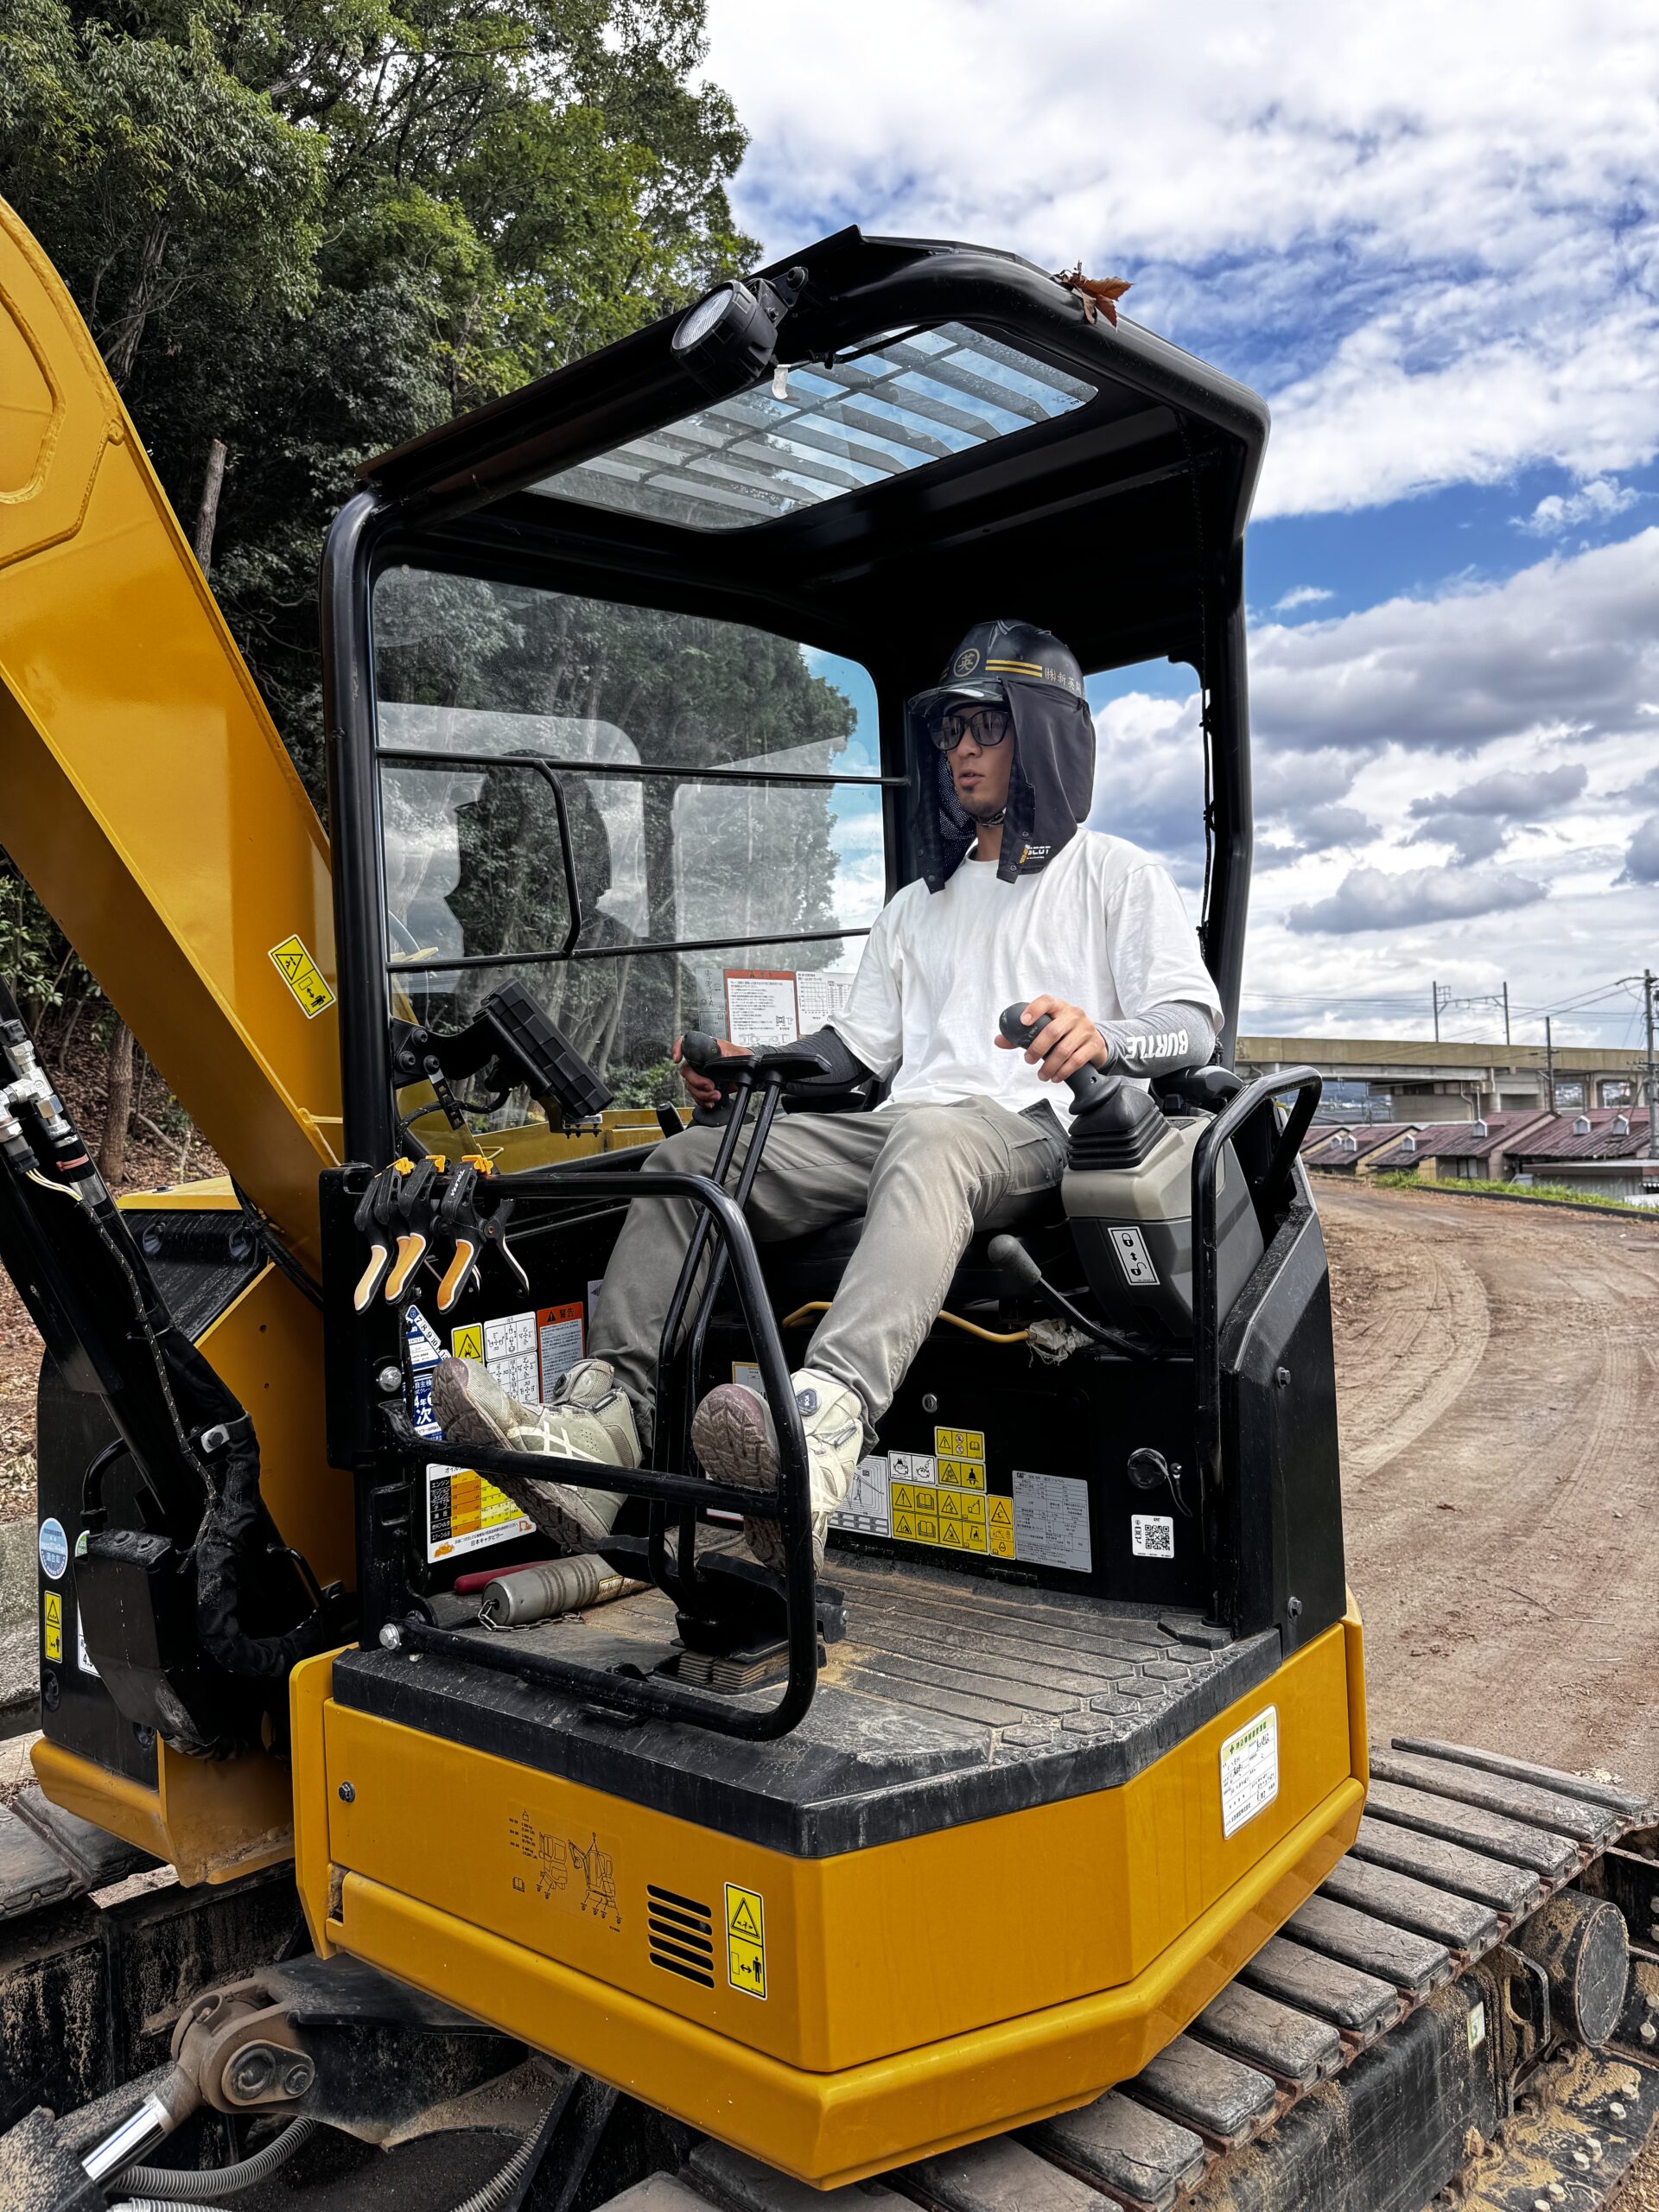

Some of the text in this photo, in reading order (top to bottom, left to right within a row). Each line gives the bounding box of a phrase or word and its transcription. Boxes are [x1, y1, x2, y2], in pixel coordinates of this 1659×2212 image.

[957, 652, 976, 673] 英
[1125, 1029, 1189, 1058] BURTLE
[559, 1308, 575, 1319] 警告
[431, 1338, 438, 1346] 10
[416, 1407, 432, 1425] 次
[471, 1533, 504, 1547] 日本キャタピラー
